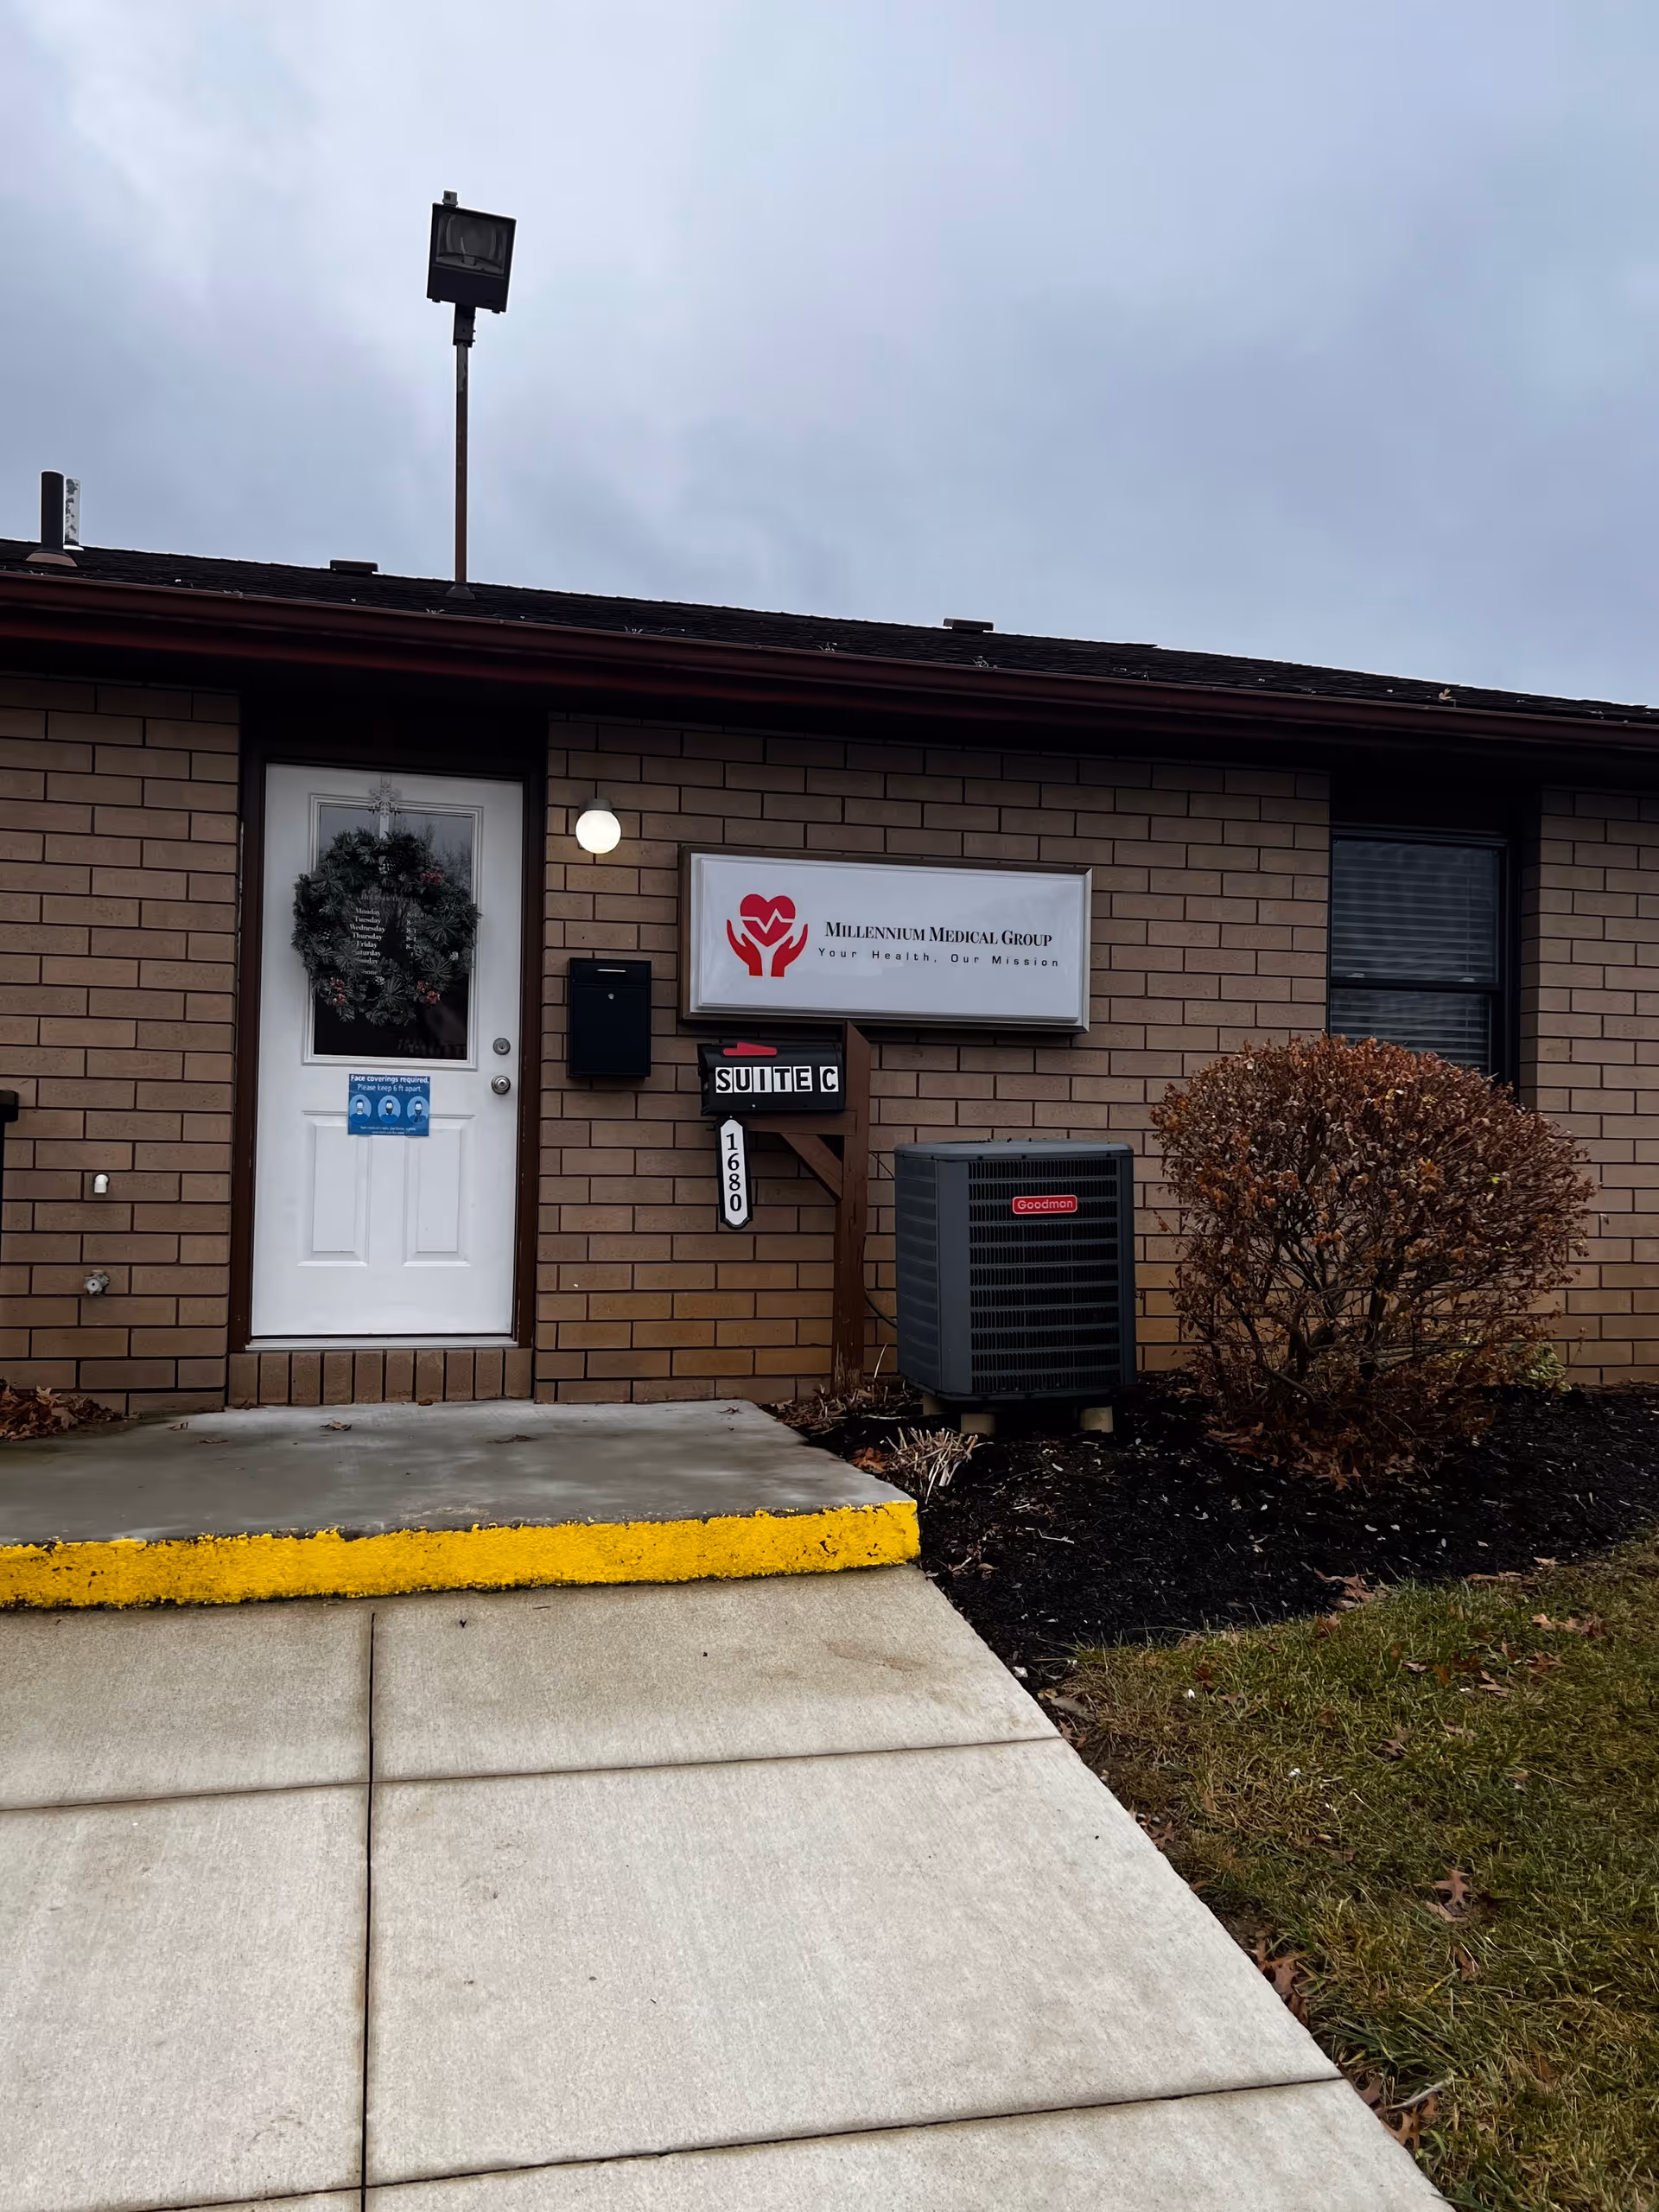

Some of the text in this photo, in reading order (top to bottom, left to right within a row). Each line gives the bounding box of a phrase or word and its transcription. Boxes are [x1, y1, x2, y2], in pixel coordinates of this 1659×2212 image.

[355, 907, 380, 916] Monday
[354, 916, 381, 925] Tuesday
[349, 924, 385, 933] Wednesday
[352, 931, 382, 941] Thursday
[818, 947, 1059, 968] Your Health, Our Mission
[366, 1076, 398, 1084] coverings
[716, 1067, 836, 1091] SUITE C
[378, 1084, 392, 1093] keep
[726, 1133, 741, 1211] 1680
[1017, 1198, 1073, 1210] Goodman
